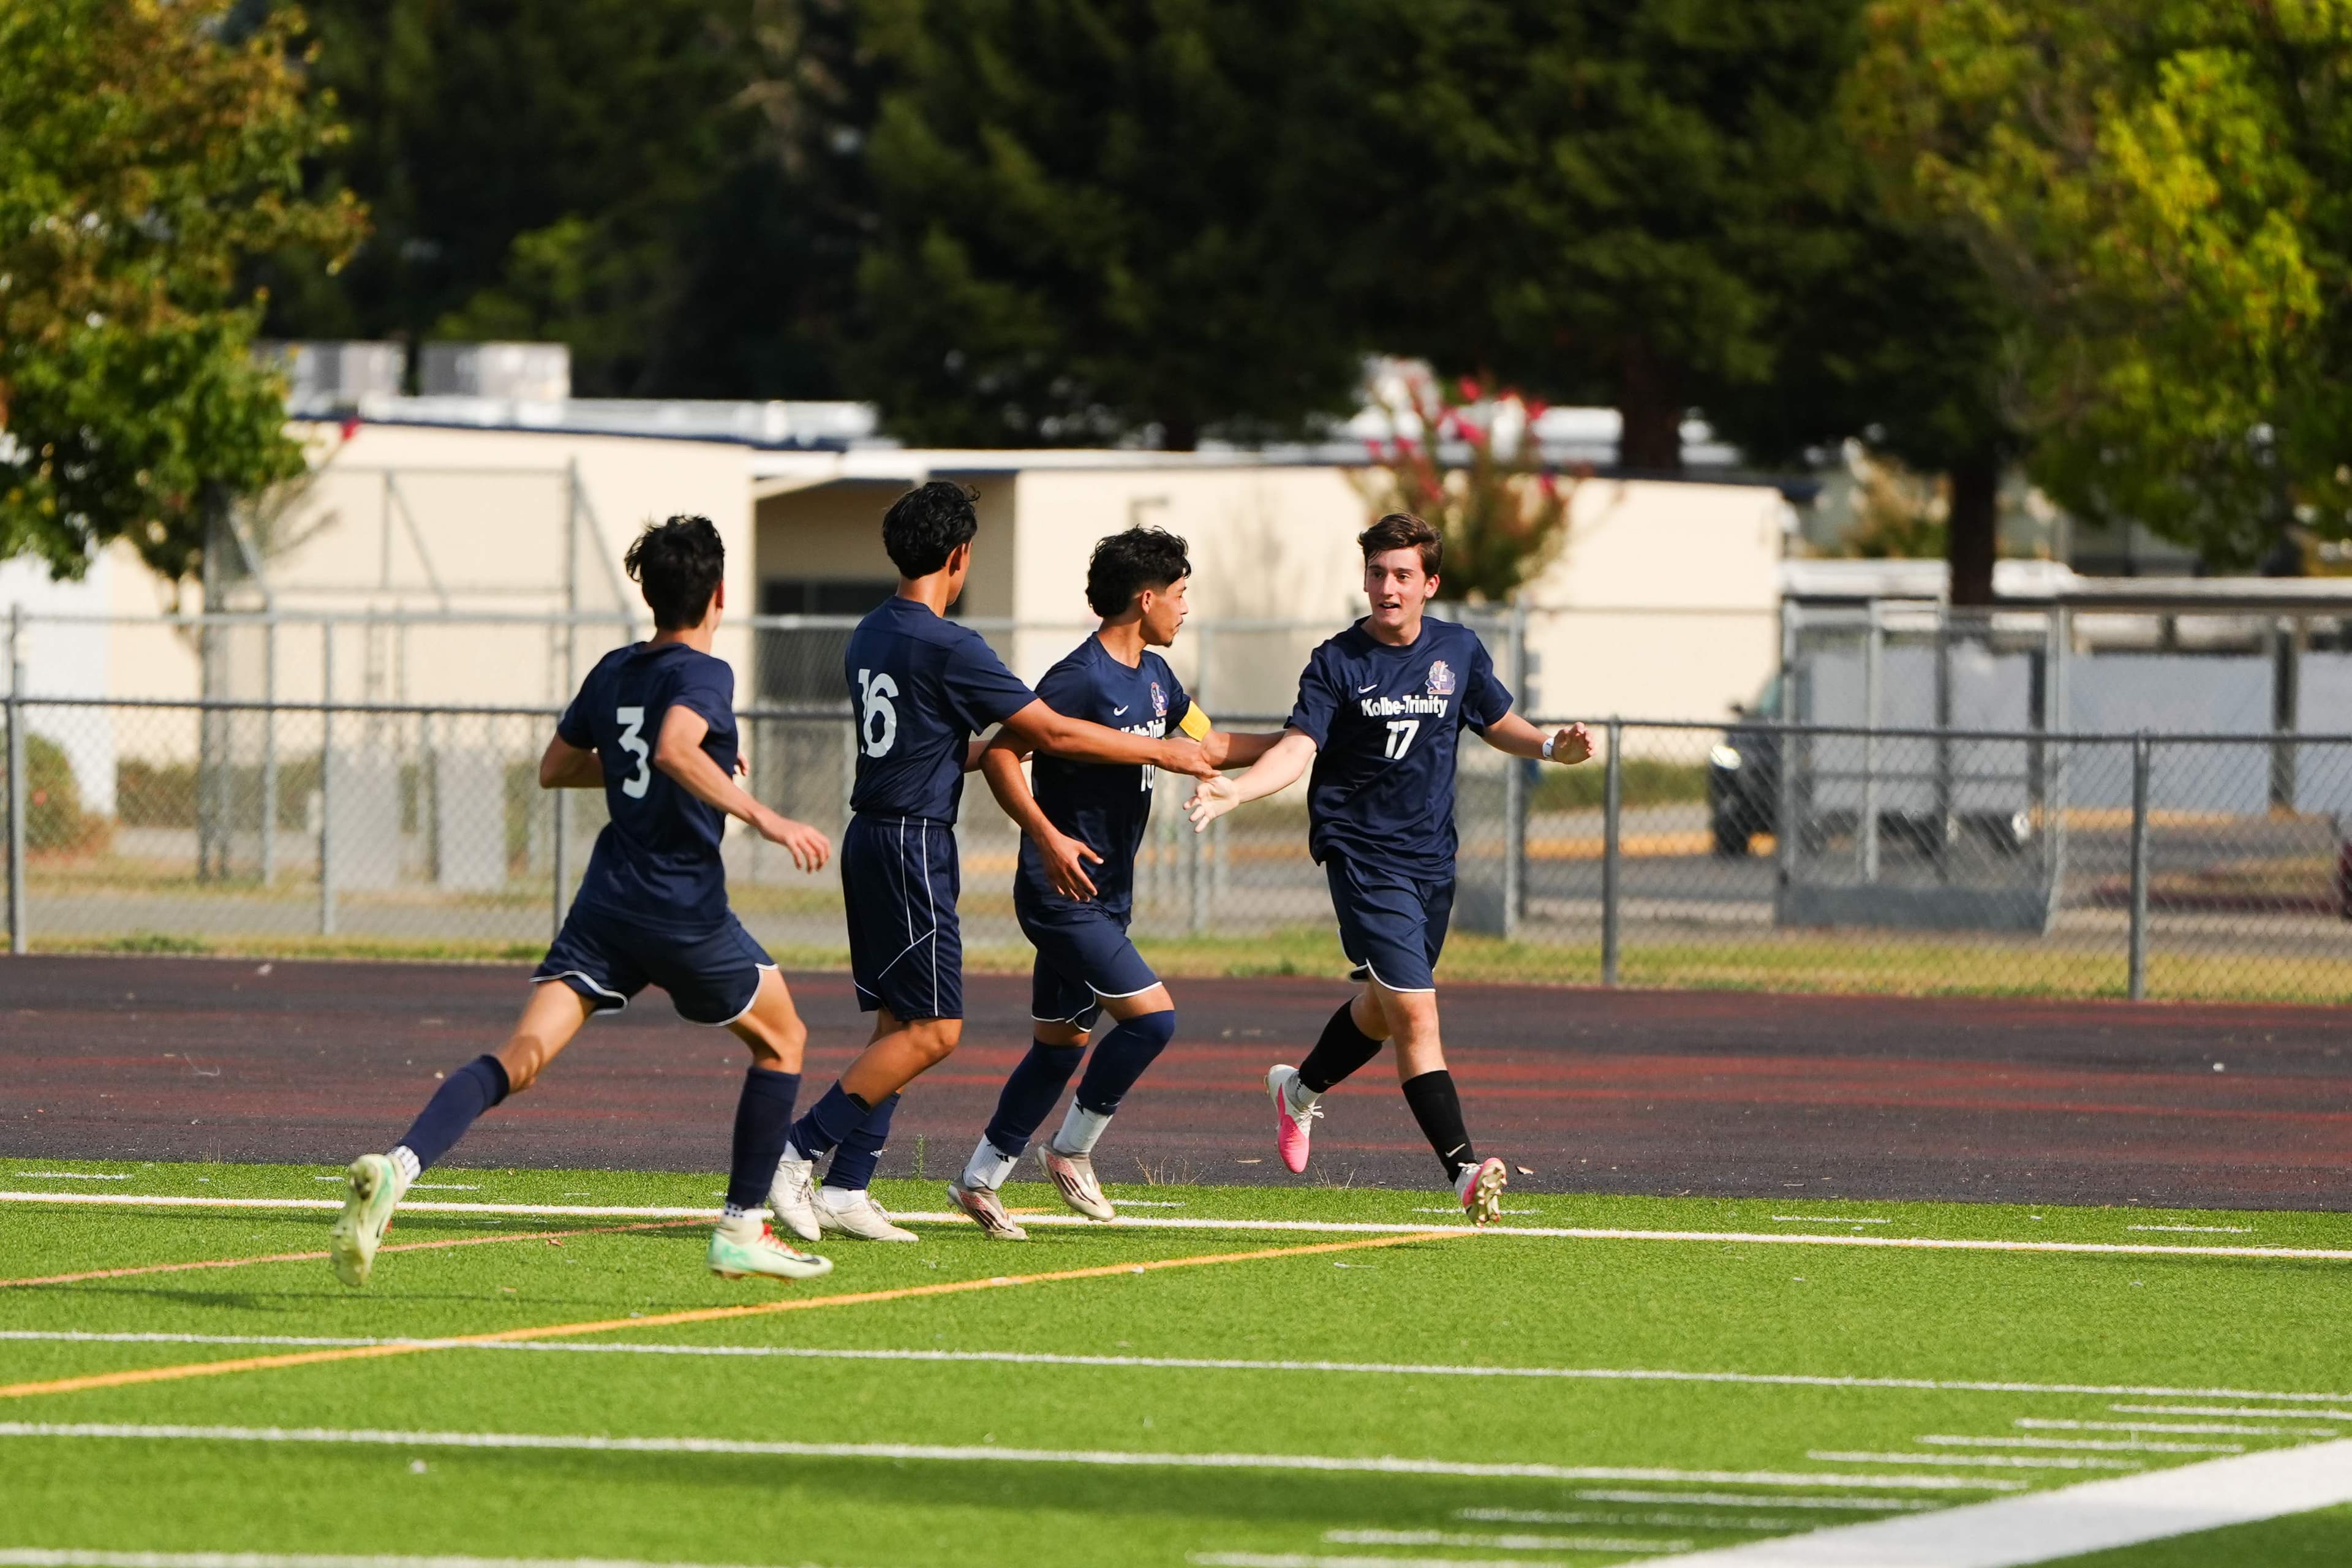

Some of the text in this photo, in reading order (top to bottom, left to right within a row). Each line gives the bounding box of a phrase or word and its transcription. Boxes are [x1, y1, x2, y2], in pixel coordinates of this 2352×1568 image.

[858, 668, 899, 758] 16
[1361, 695, 1448, 718] Kolbe-Trinity
[617, 706, 650, 799] 3
[1385, 720, 1420, 760] 17
